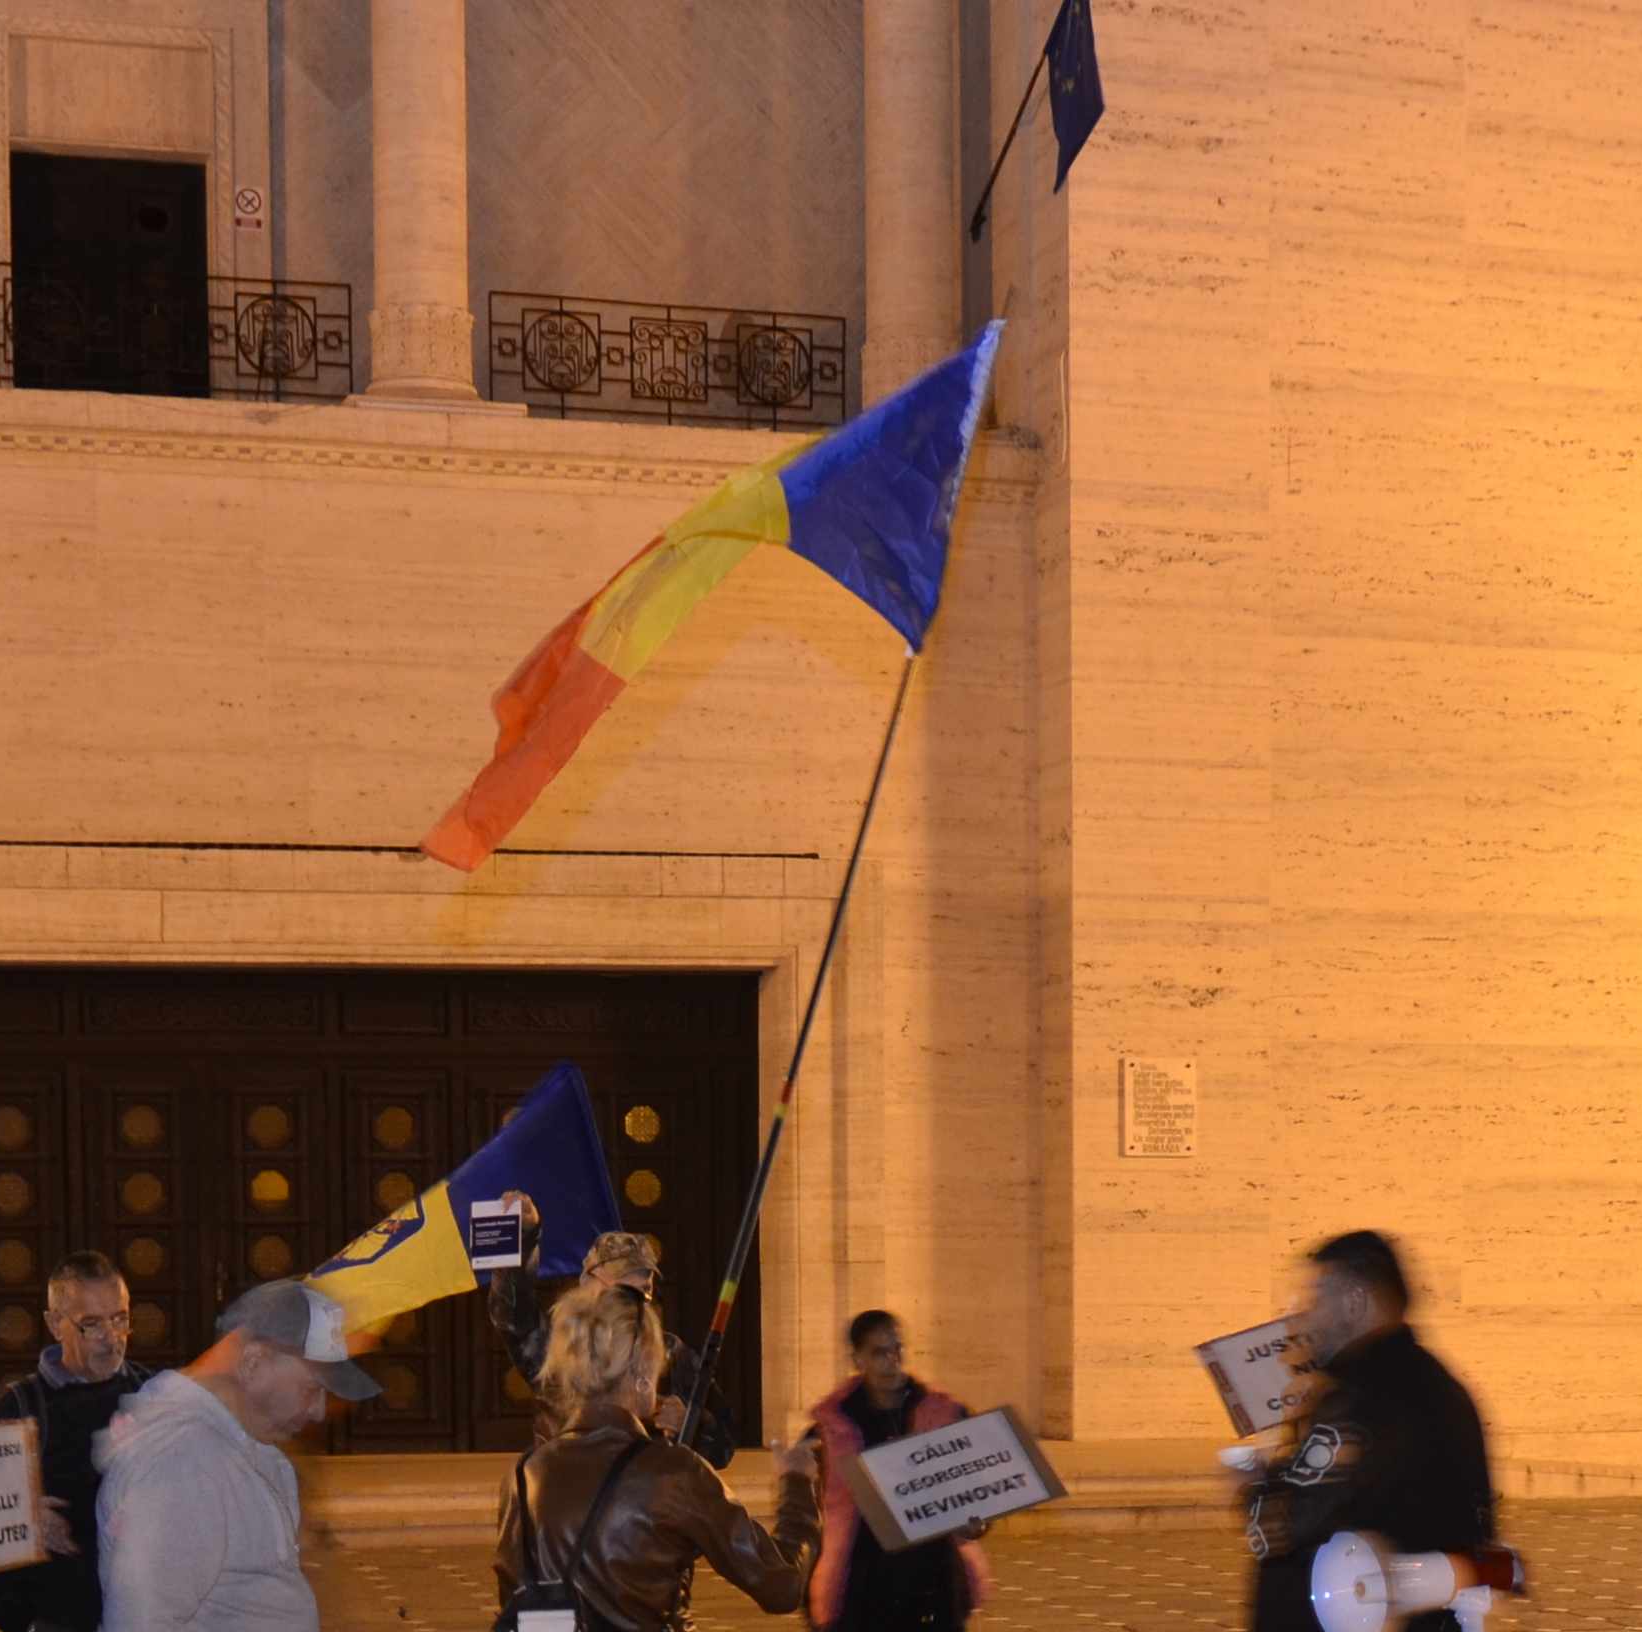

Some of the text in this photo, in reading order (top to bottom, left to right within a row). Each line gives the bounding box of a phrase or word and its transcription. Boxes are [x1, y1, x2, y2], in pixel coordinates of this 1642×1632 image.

[894, 1450, 1012, 1495] GEORGESCU
[909, 1436, 972, 1465] CĂLIN
[905, 1473, 1027, 1523] NEVINOVAT
